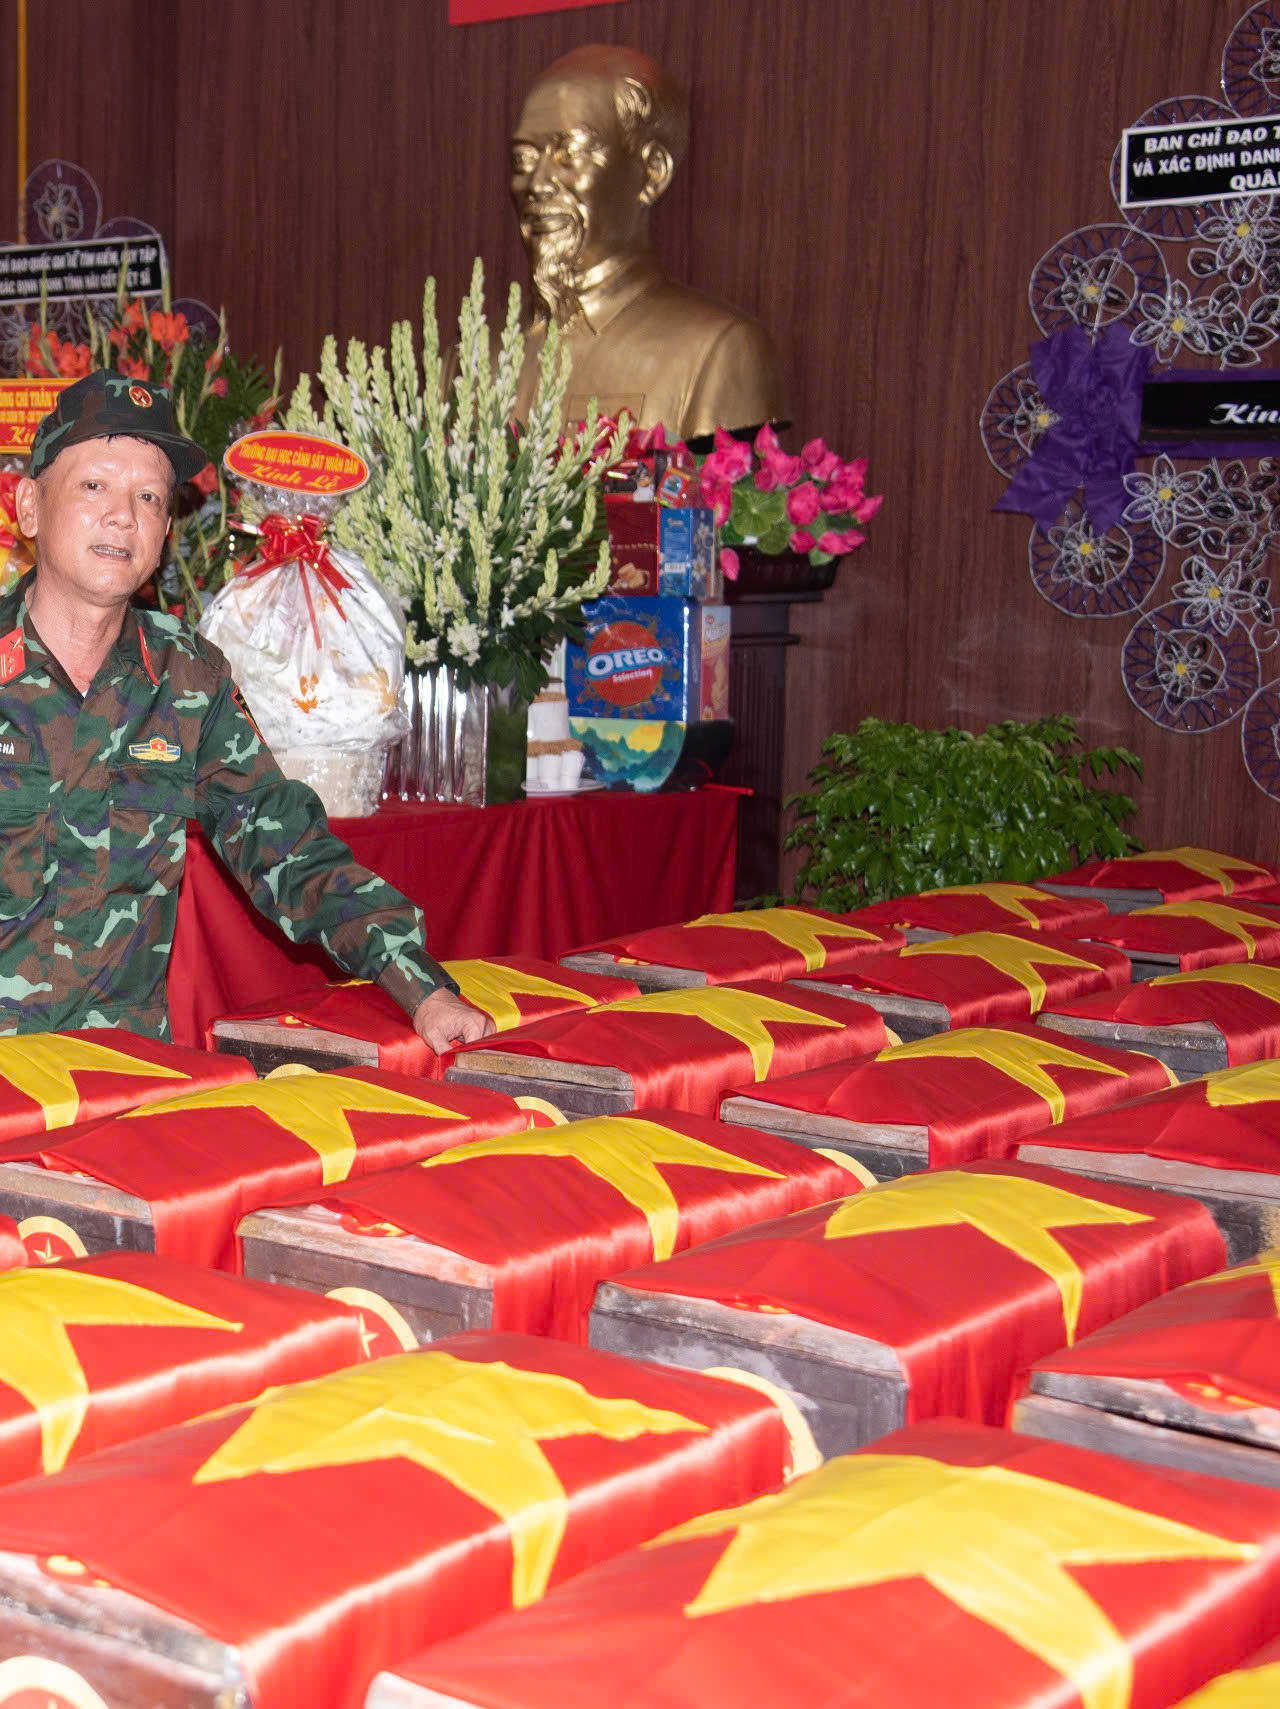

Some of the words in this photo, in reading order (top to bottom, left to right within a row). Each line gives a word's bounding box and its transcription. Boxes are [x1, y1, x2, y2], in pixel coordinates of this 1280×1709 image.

[1144, 135, 1184, 153] BAN
[1187, 127, 1222, 148] CHỈ
[1226, 127, 1268, 146] ĐẠO
[1132, 157, 1154, 177] VÀ
[1158, 154, 1191, 174] XÁC
[1195, 152, 1236, 172] ĐỊNH
[1230, 168, 1280, 191] QUÂ
[588, 648, 663, 676] OREO
[2, 742, 15, 755] HÀ
